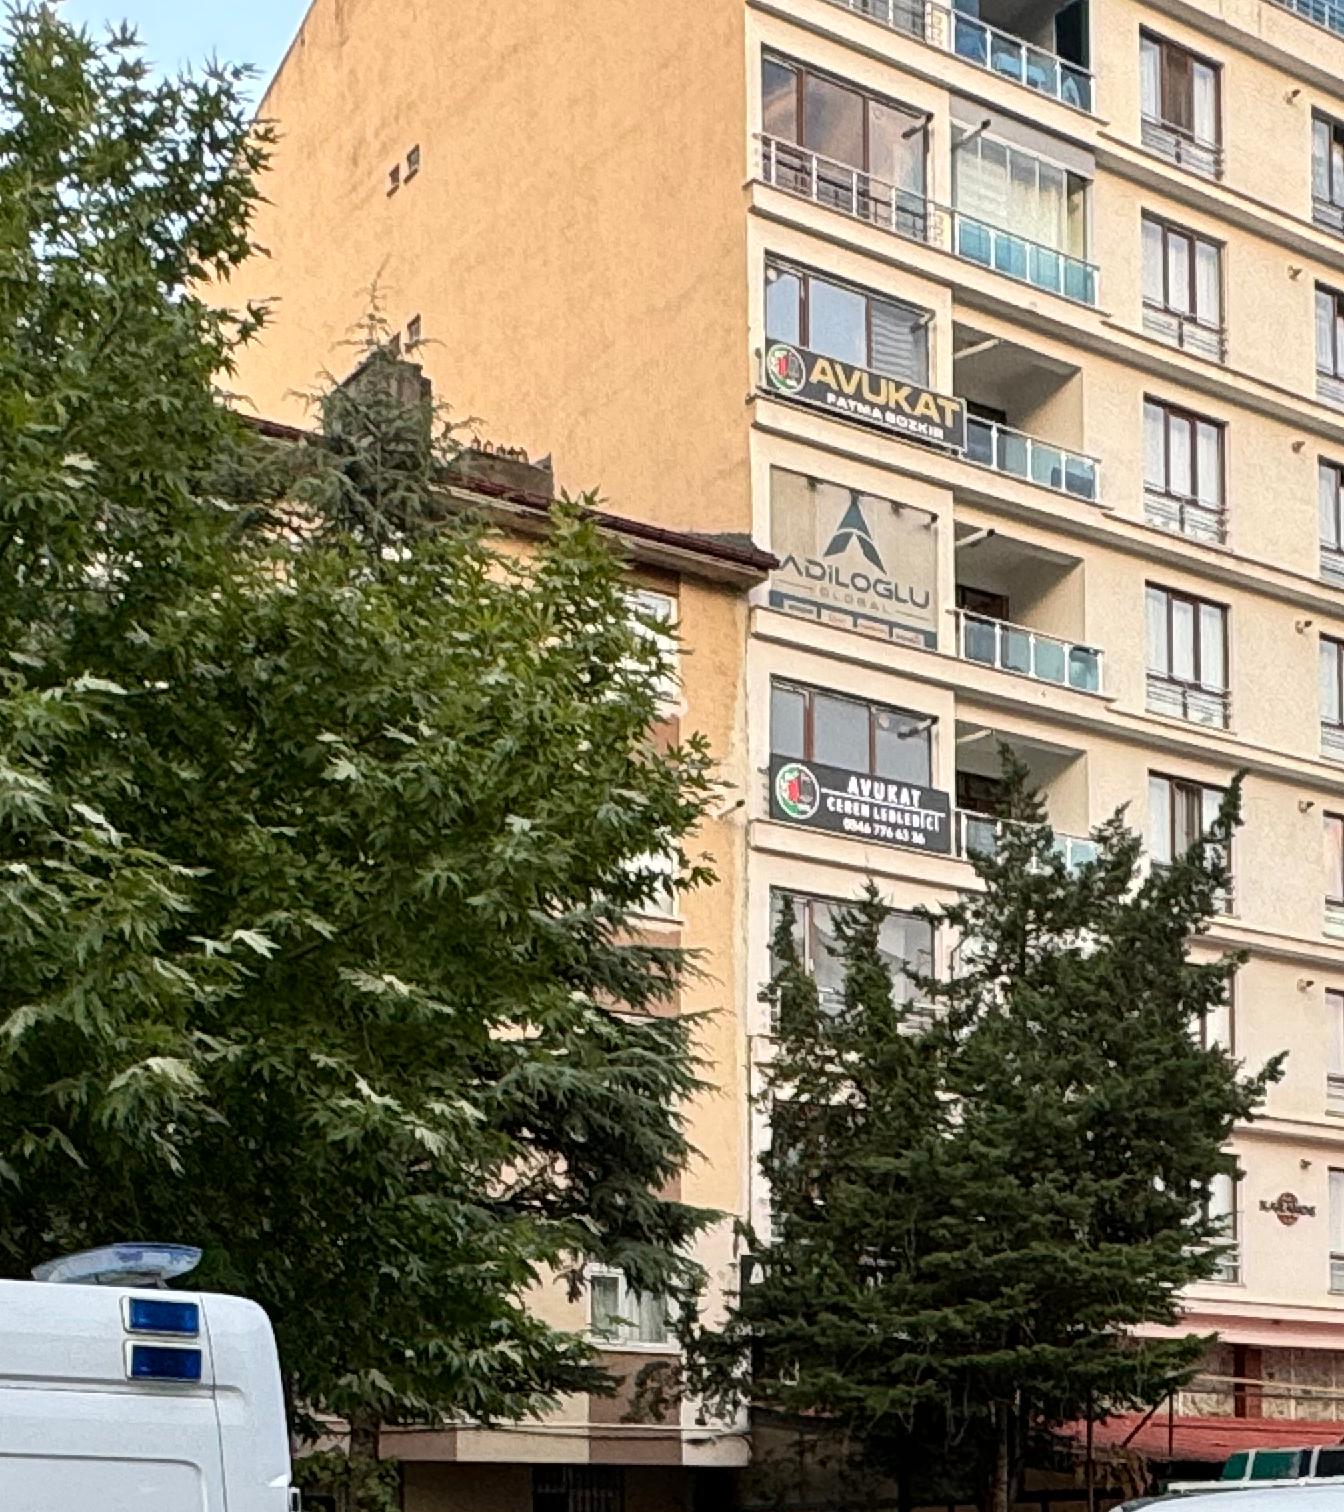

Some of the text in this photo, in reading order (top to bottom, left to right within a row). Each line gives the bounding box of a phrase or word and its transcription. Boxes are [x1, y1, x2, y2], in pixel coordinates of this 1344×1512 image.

[809, 358, 961, 428] AVUKAT
[826, 796, 870, 818] CEREN
[847, 775, 922, 809] AVUKAT
